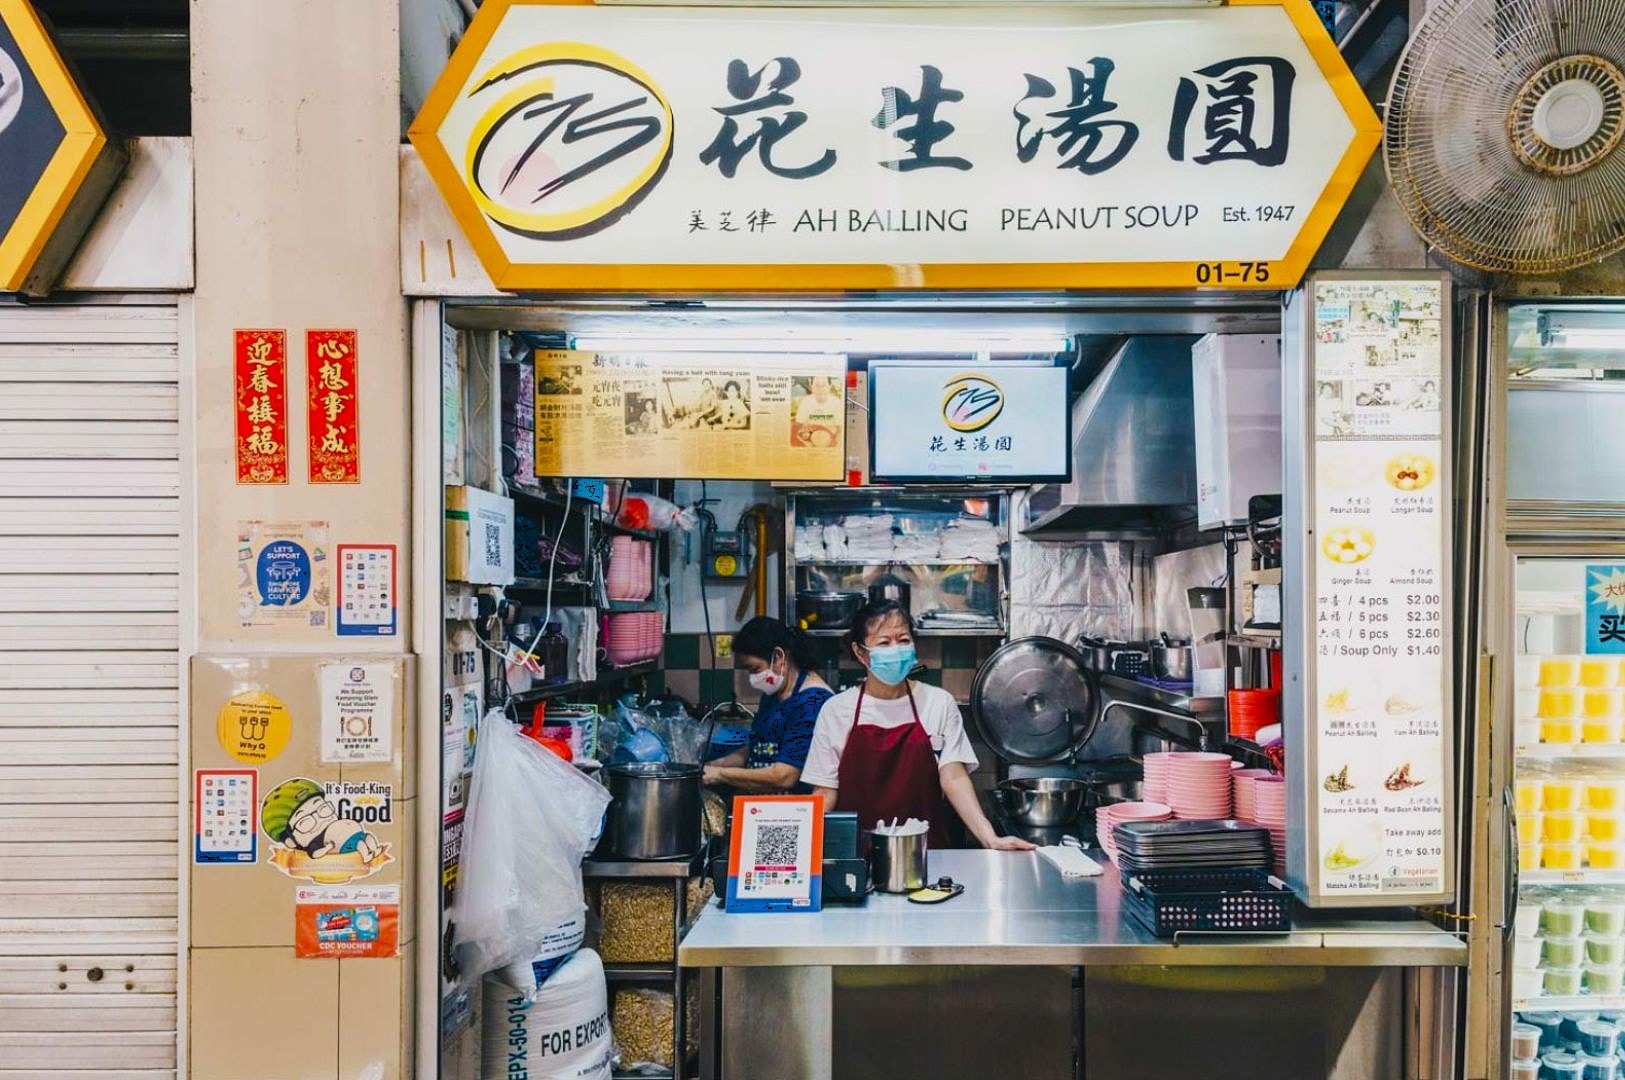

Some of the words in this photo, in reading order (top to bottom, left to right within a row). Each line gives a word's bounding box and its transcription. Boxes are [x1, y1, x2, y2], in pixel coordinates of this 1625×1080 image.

[699, 55, 1297, 180] 花生湯圓
[688, 208, 777, 234] 美芝律
[793, 208, 837, 232] AH
[848, 208, 968, 233] BALLING
[1000, 206, 1119, 231] PEANUT
[1124, 204, 1199, 229] SOUP
[1222, 206, 1251, 222] Est.
[1255, 205, 1296, 222] 1947
[245, 336, 279, 455] 迎春接福
[316, 339, 350, 454] 心想事成
[928, 435, 1012, 453] 花生湯圓
[266, 552, 301, 560] SUPPORT
[1368, 598, 1389, 607] pcs
[1406, 594, 1440, 605] $2.00
[1368, 614, 1389, 623] pcs
[1406, 611, 1440, 622] $2.30
[1368, 631, 1389, 640] pcs
[1406, 628, 1440, 639] $2.60
[1340, 645, 1370, 657] Soup
[1372, 645, 1398, 657] Only
[1406, 645, 1440, 656] $1.40
[351, 689, 374, 697] Support
[325, 783, 341, 794] It's
[343, 783, 391, 796] Food-King
[338, 798, 392, 823] Good
[1415, 848, 1442, 857] $0.10
[337, 942, 373, 950] VOUCHER
[541, 1029, 572, 1057] FOR
